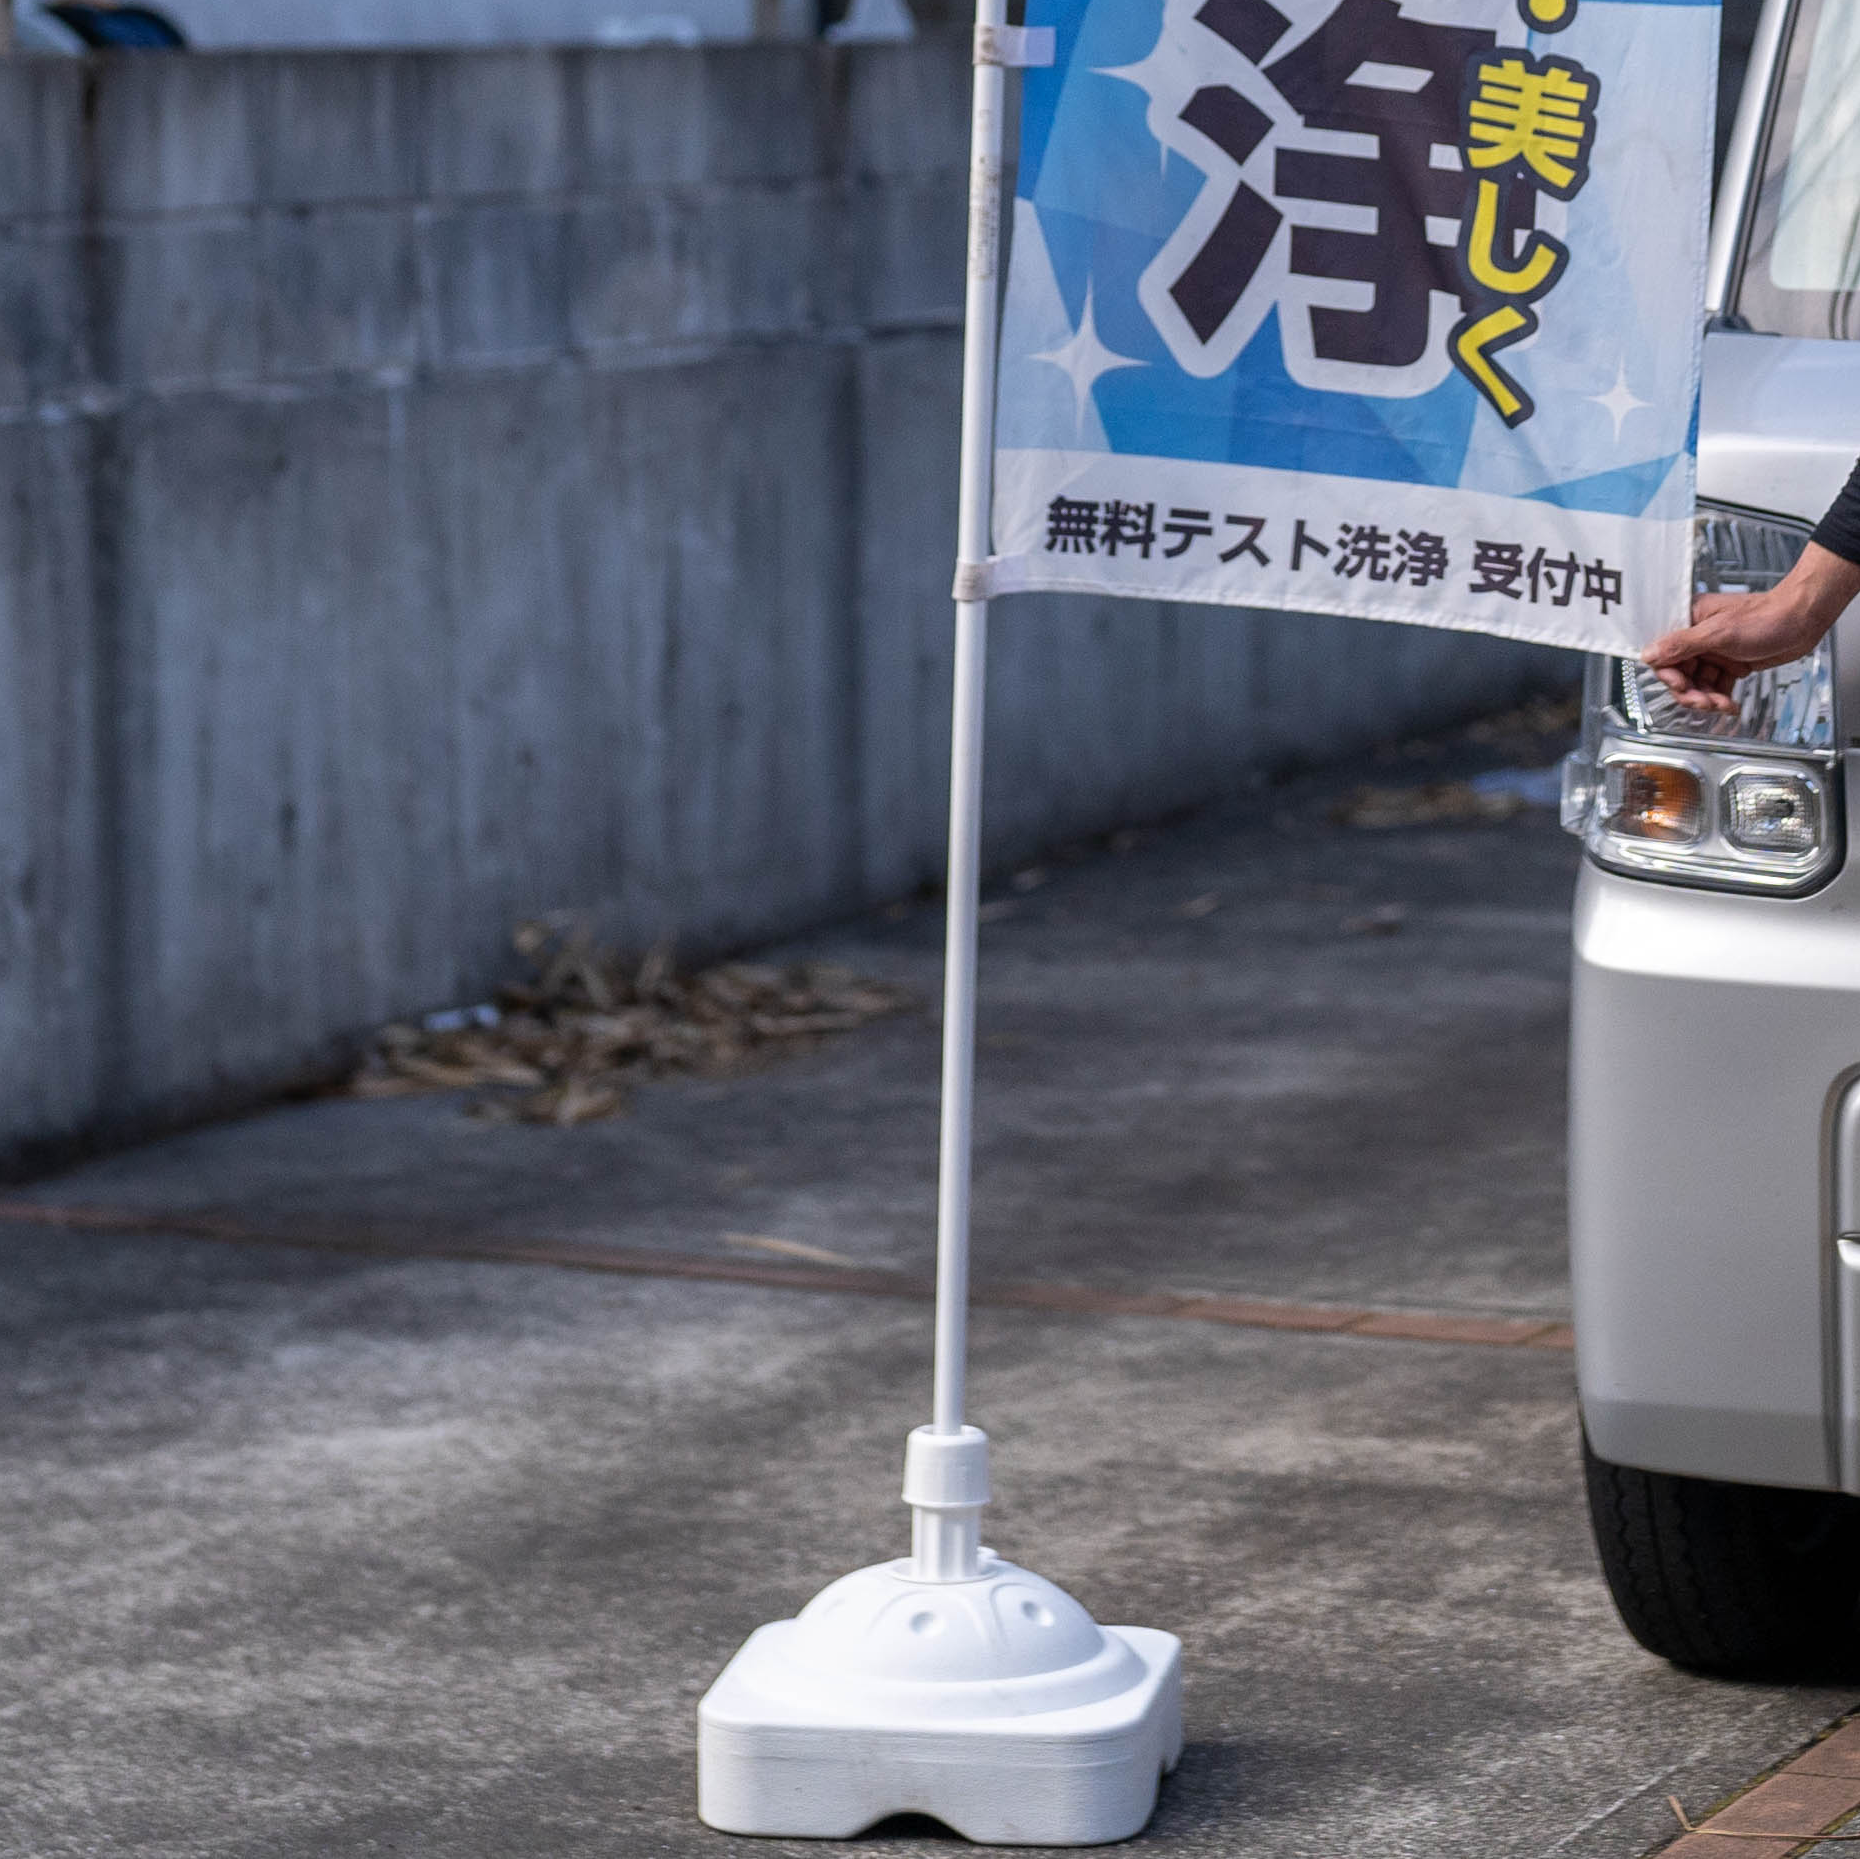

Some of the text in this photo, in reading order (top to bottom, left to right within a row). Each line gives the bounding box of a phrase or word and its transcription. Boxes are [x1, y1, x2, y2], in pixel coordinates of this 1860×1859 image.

[1044, 493, 1624, 616] 無料テスト洗浄 受付中
